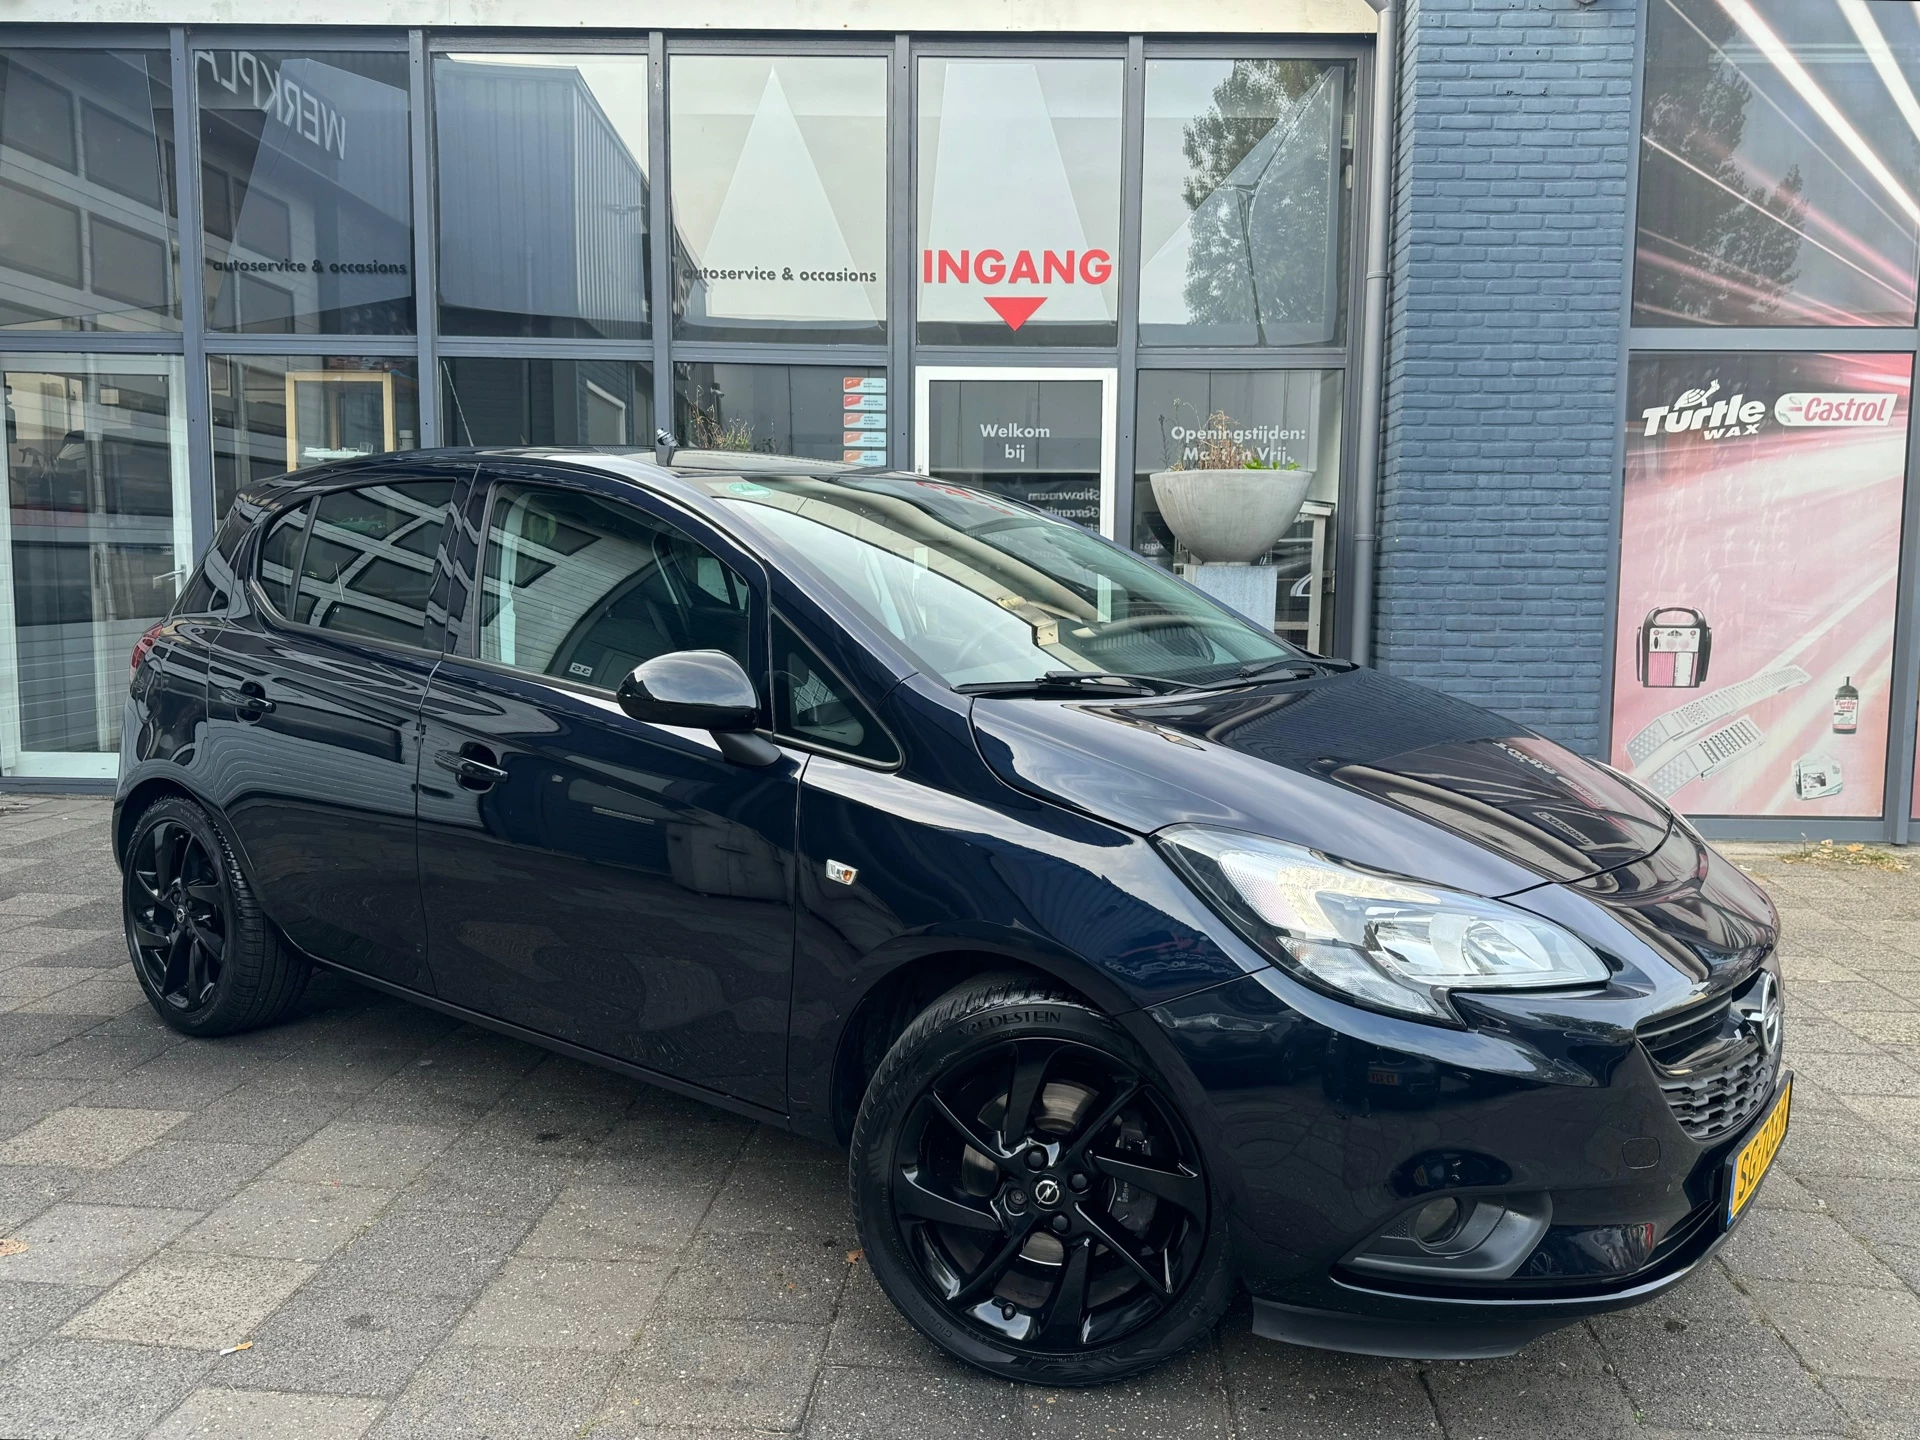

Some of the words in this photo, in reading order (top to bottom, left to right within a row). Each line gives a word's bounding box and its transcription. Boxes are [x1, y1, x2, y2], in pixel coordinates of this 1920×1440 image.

[213, 258, 306, 272] autoservice
[311, 259, 324, 274] &
[329, 260, 408, 275] occasions
[682, 266, 776, 281] autoservice
[782, 267, 794, 281] &
[800, 268, 877, 282] occasions
[923, 248, 1112, 285] INGANG
[1642, 393, 1766, 437] Turtle
[1803, 396, 1888, 423] Castrol
[980, 423, 1050, 438] Welkom
[1171, 425, 1306, 443] Openingstijden:
[1703, 424, 1760, 441] WAX
[1005, 444, 1025, 462] bij
[958, 1010, 1062, 1036] VREDESTEIN
